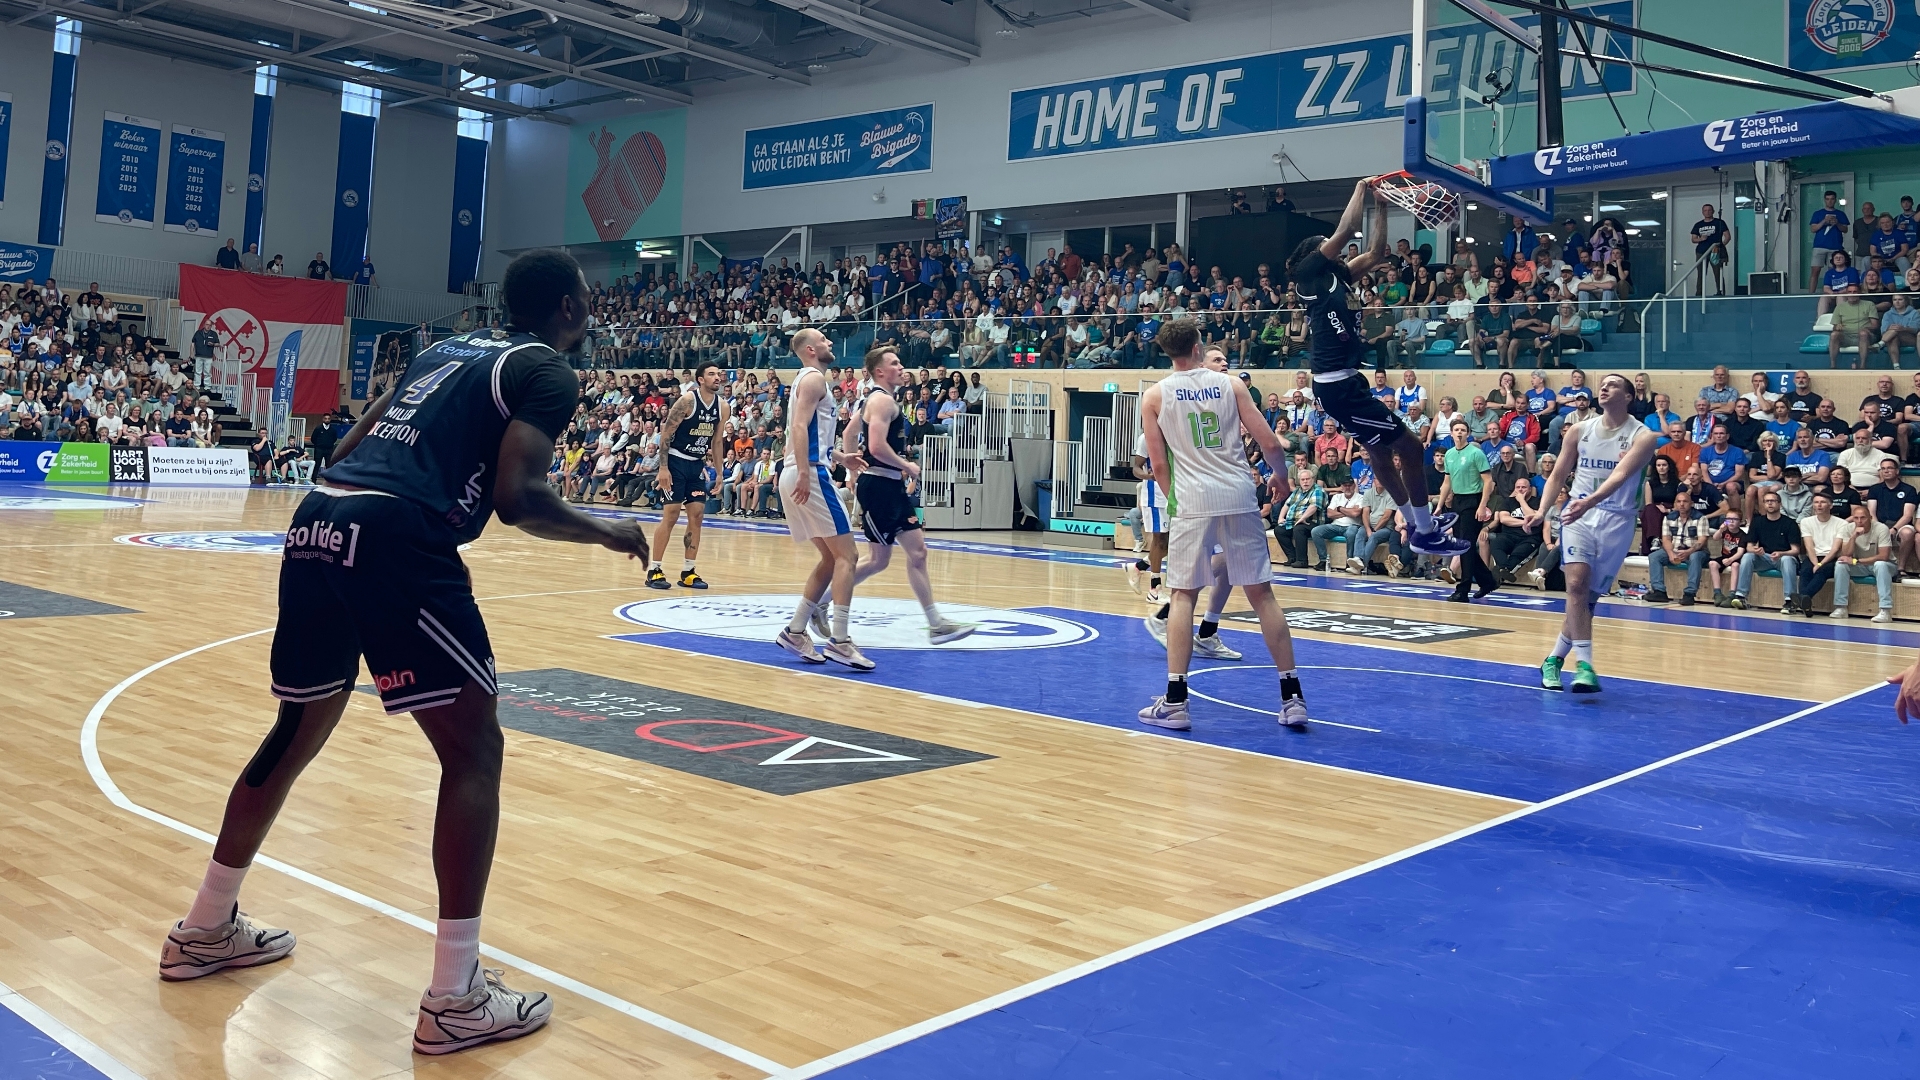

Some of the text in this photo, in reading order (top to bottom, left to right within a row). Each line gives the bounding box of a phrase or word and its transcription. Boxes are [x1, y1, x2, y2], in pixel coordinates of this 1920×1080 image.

[1821, 20, 1878, 37] LEIDEN
[1839, 43, 1861, 53] 2006
[1033, 79, 1166, 150] HOME
[1176, 68, 1244, 133] OF
[1295, 50, 1370, 118] ZZ
[1740, 115, 1783, 128] Zorg en
[119, 129, 146, 143] Beker
[860, 122, 905, 147] Blauwe
[1741, 122, 1798, 139] Zekerheid
[113, 141, 149, 153] winnaar
[753, 133, 845, 158] GA STAAN ALS JE
[871, 133, 919, 160] Brigade
[1771, 138, 1789, 147] jouw
[1790, 135, 1810, 143] buurt
[178, 143, 217, 160] Supercup
[1566, 142, 1604, 154] Zorg en
[121, 155, 139, 163] 2010
[752, 148, 851, 173] VOOR LEIDEN BENT!
[1566, 148, 1617, 164] Zekerheid
[121, 165, 138, 173] 2012
[188, 166, 205, 175] 2012
[1593, 163, 1609, 171] jouw
[120, 174, 137, 183] 2019
[187, 176, 204, 184] 2013
[119, 184, 137, 193] 2023
[186, 185, 204, 194] 2022
[185, 194, 203, 203] 2023
[185, 204, 202, 212] 2024
[114, 303, 130, 311] VAK
[400, 361, 464, 405] 4
[1780, 374, 1789, 386] C
[1175, 386, 1221, 401] SICKING
[1188, 411, 1222, 449] 12
[61, 453, 78, 461] Zorg
[113, 450, 144, 458] HART
[196, 457, 207, 466] bij
[115, 472, 144, 480] ZAAK
[229, 468, 246, 476] zijn!
[964, 497, 971, 515] B
[1065, 524, 1090, 533] VAK
